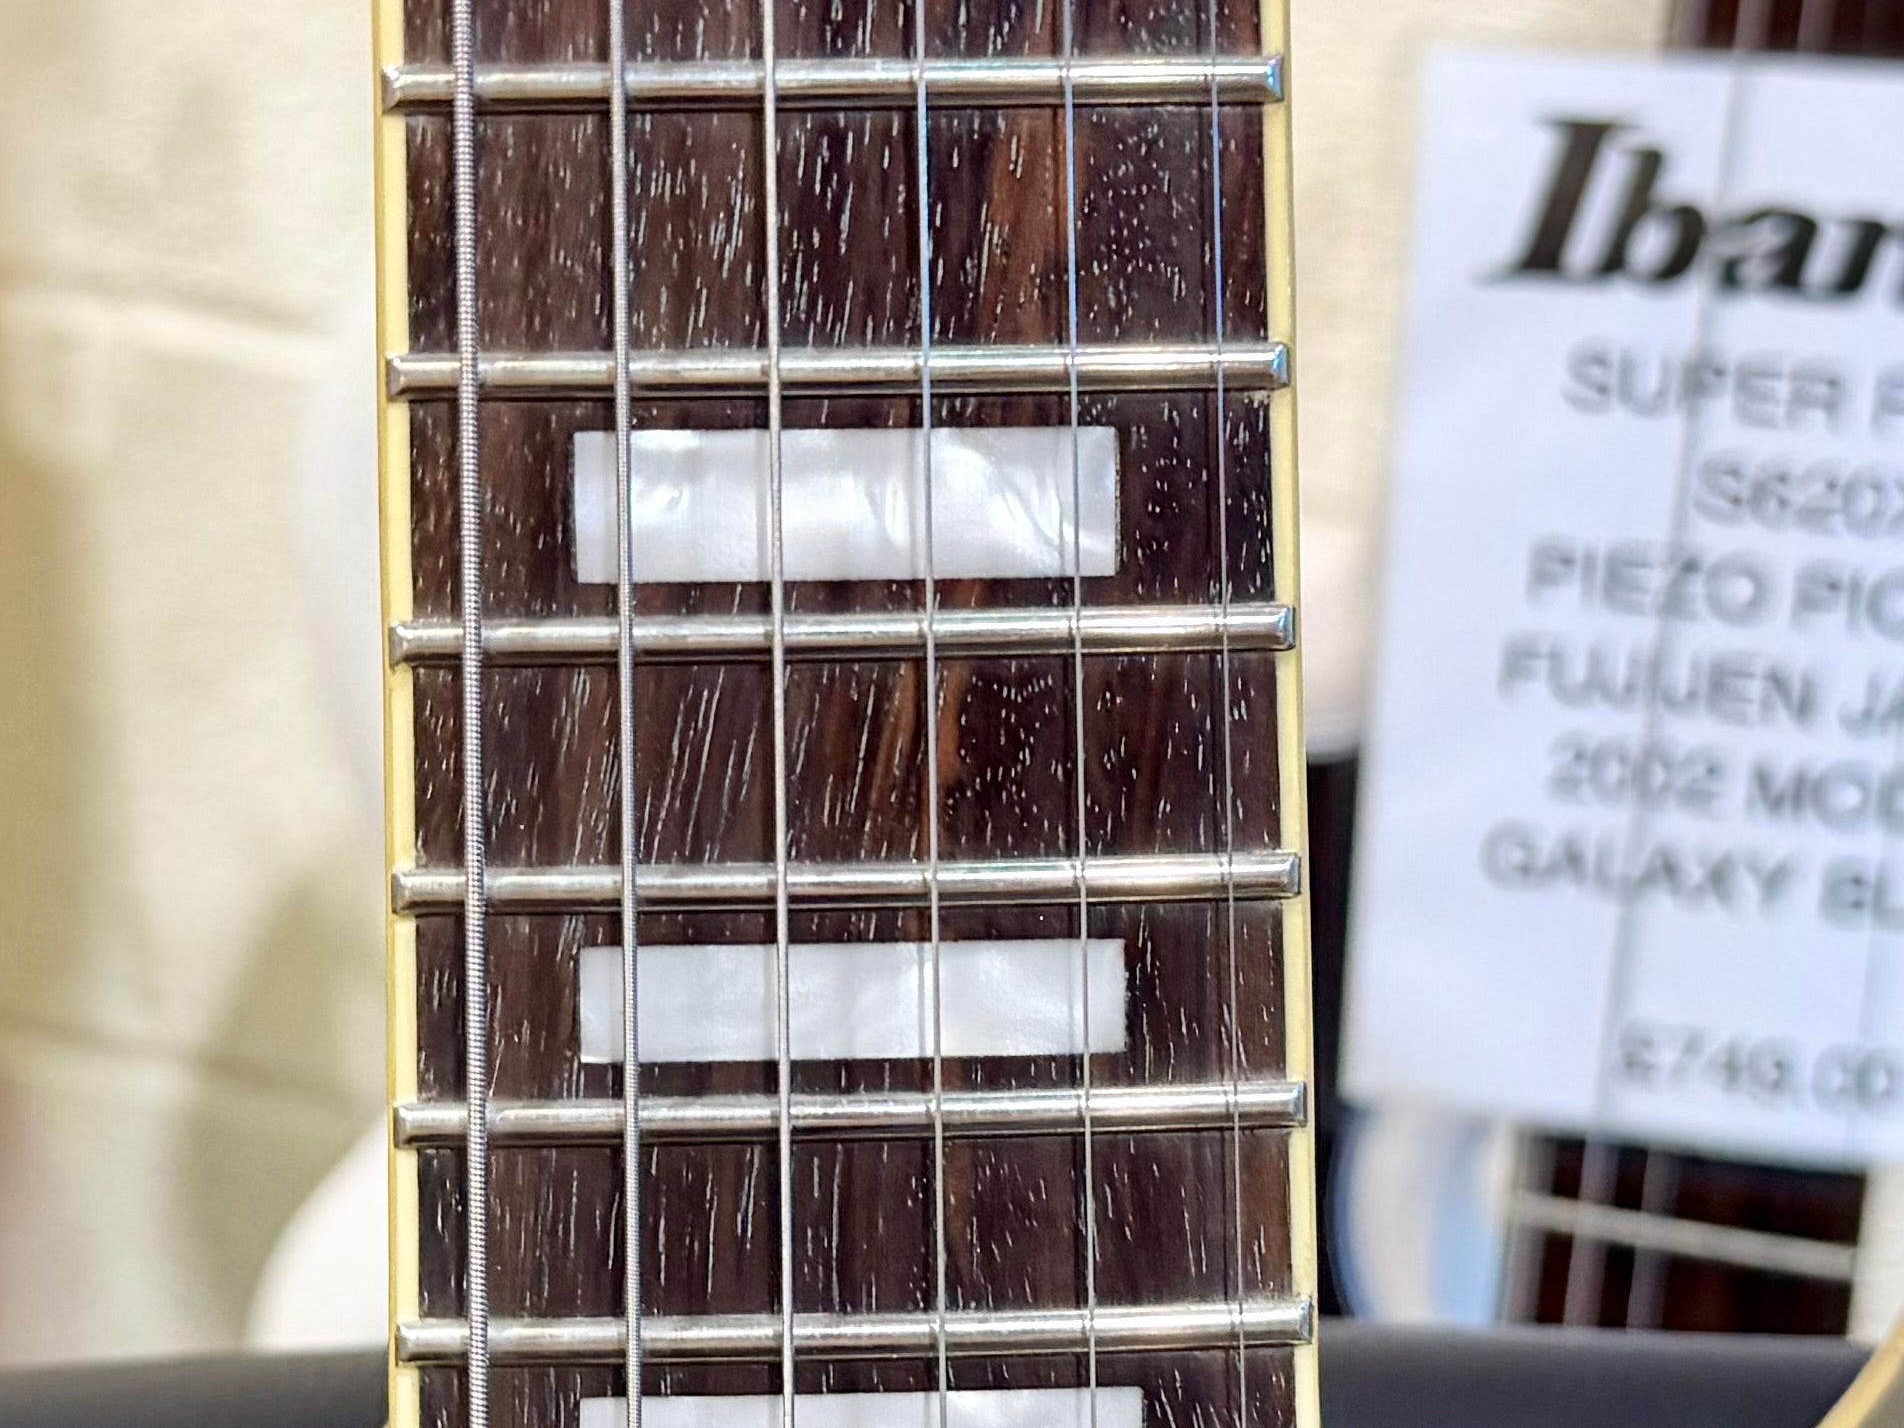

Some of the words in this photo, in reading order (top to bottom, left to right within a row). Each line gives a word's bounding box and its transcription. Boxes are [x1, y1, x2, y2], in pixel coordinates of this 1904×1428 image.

[1562, 334, 1841, 434] SUPER
[1526, 535, 1771, 627] PIEZO
[1546, 732, 1723, 818] 2002
[1481, 820, 1798, 919] GALAXY
